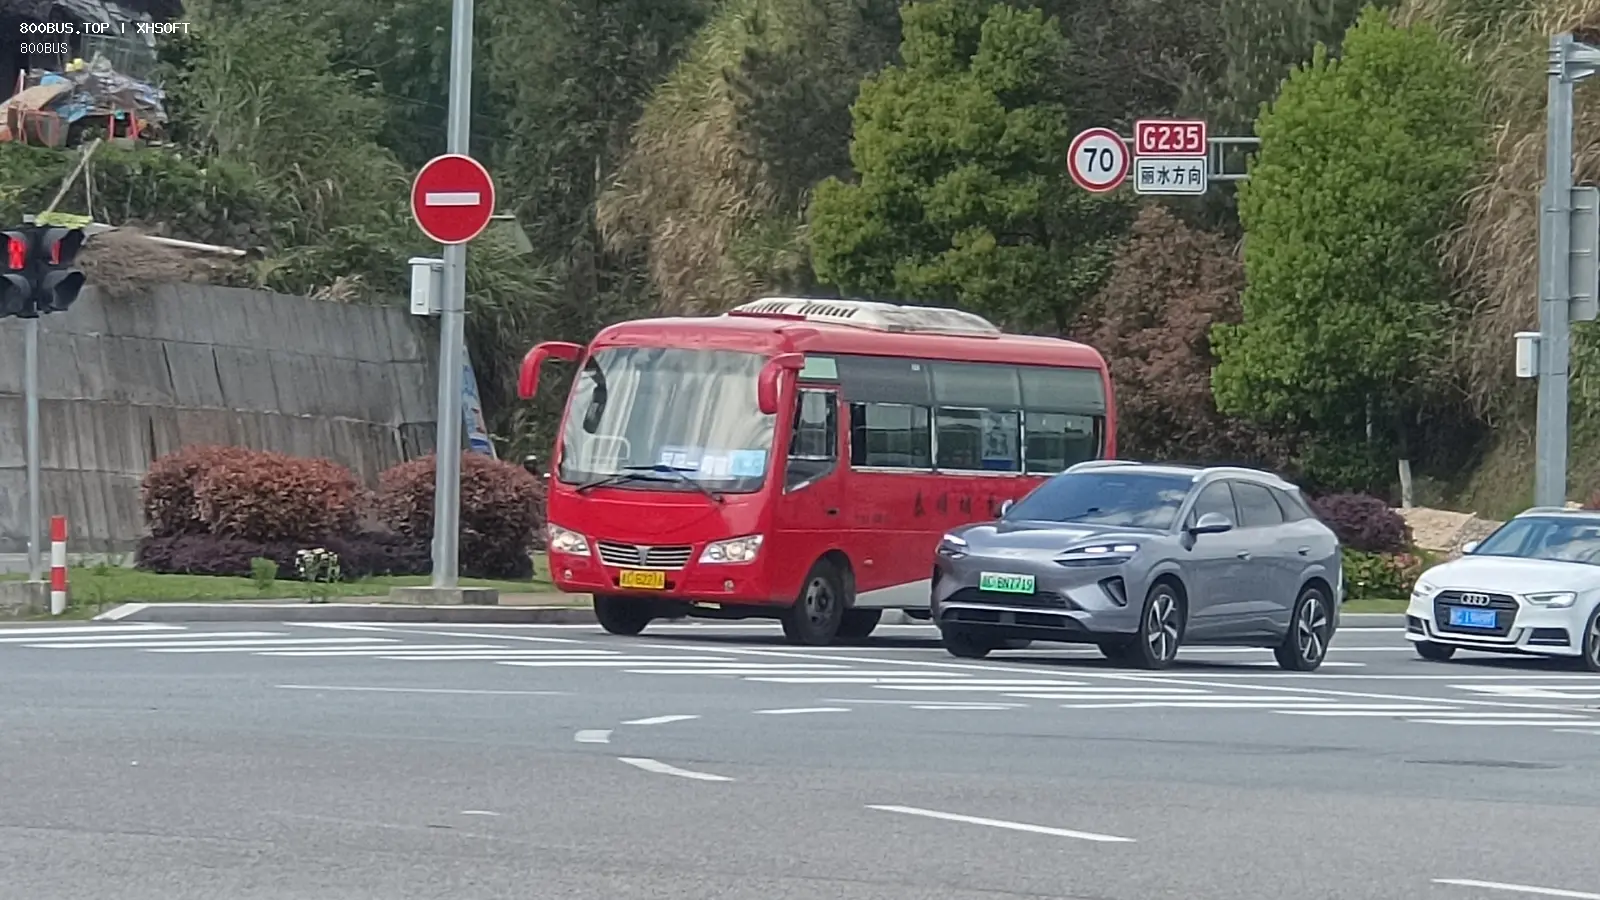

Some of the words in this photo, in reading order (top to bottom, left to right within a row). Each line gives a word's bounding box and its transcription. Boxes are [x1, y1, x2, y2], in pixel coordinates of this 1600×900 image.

[1143, 126, 1199, 150] G235
[1083, 148, 1114, 172] 70
[1140, 165, 1201, 185] 丽水方向
